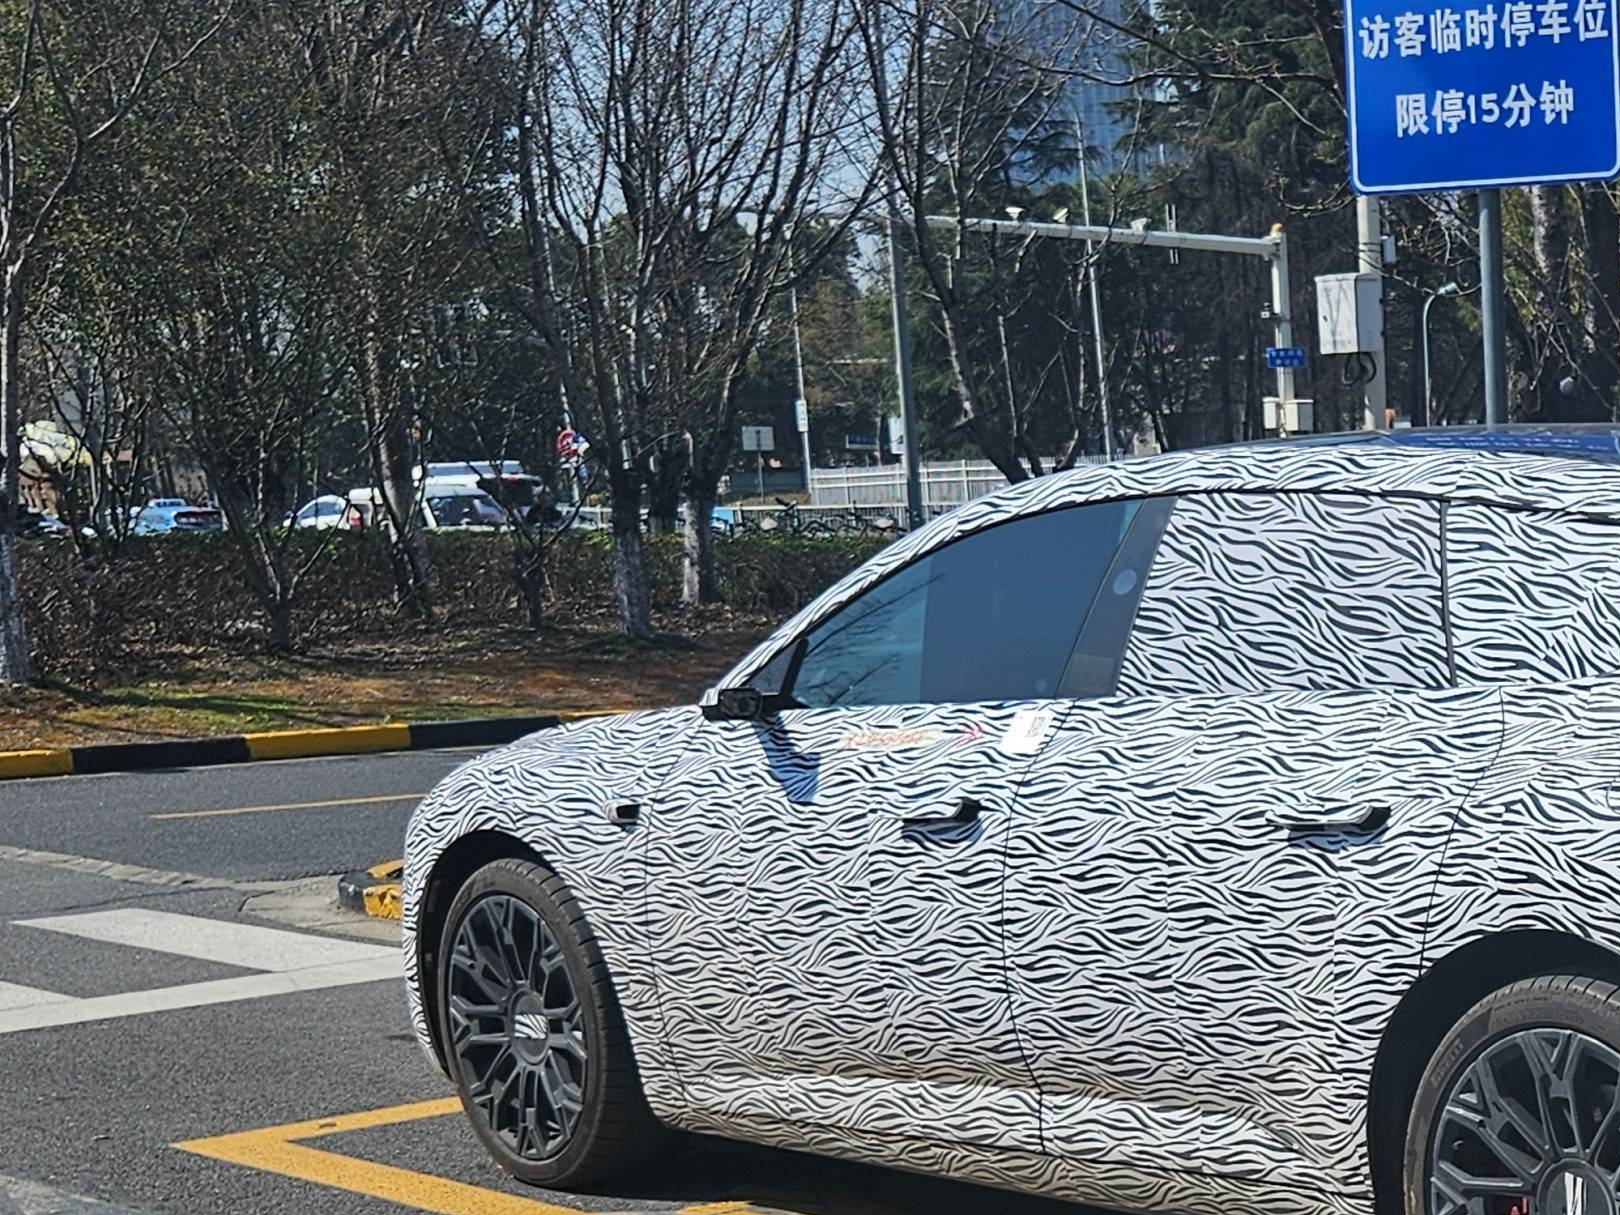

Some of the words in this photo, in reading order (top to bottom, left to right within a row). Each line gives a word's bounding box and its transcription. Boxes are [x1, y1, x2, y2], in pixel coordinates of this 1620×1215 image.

[1358, 0, 1609, 59] 访客临时停车位
[1396, 80, 1574, 138] 限停15分钟
